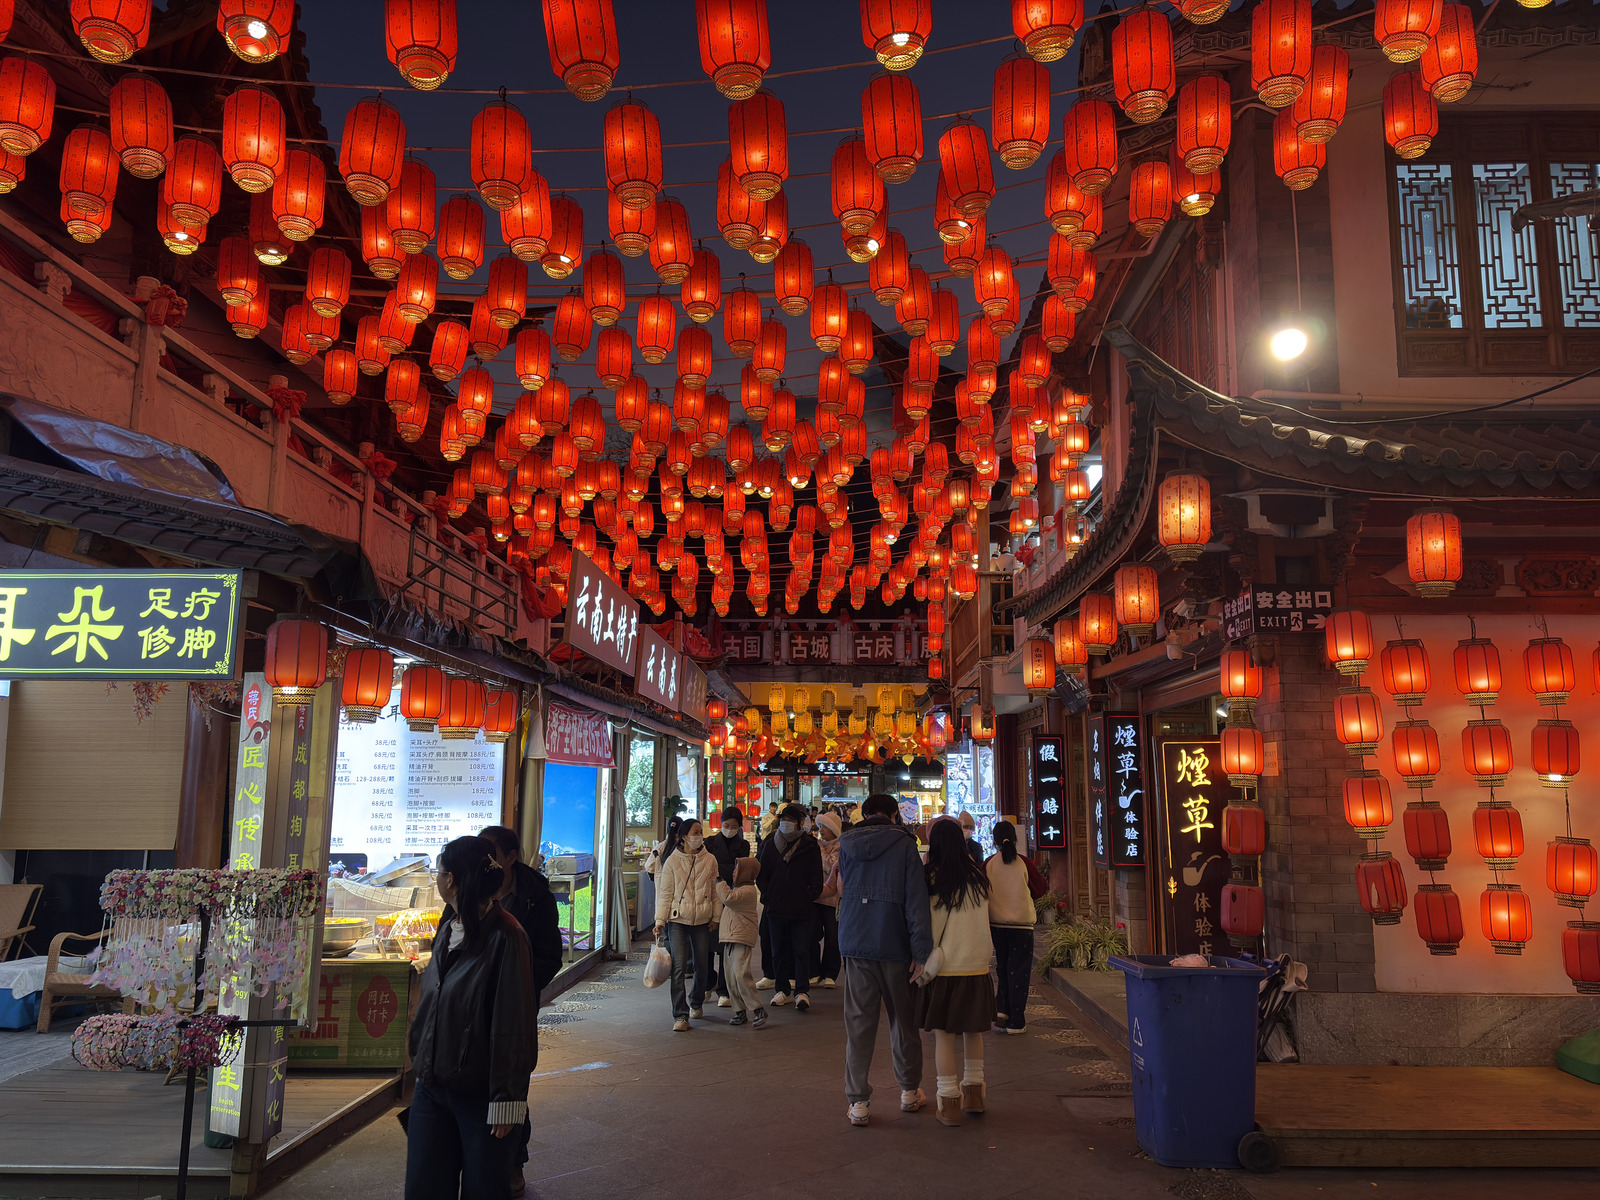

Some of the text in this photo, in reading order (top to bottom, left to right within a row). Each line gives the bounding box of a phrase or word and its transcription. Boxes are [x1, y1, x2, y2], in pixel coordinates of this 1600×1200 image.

[139, 587, 221, 620] 足疗
[1224, 593, 1251, 619] 安全出口
[1256, 591, 1332, 609] 安全出口
[576, 575, 637, 664] 云南土特产
[1260, 616, 1288, 627] EXIT
[138, 625, 216, 659] 修脚
[723, 636, 761, 658] 古国
[791, 636, 829, 659] 古城
[855, 636, 893, 659] 古床
[1114, 725, 1138, 779] 煙草
[236, 746, 265, 871] 匠心传承
[289, 744, 308, 869] 成都掏耳
[1039, 745, 1061, 841] 假一赔十
[1176, 747, 1214, 844] 煙草
[1124, 811, 1139, 856] 体验店
[368, 990, 390, 1006] 网红
[367, 1008, 389, 1023] 打卡
[211, 1105, 240, 1117] preservation
[218, 1097, 234, 1106] health
